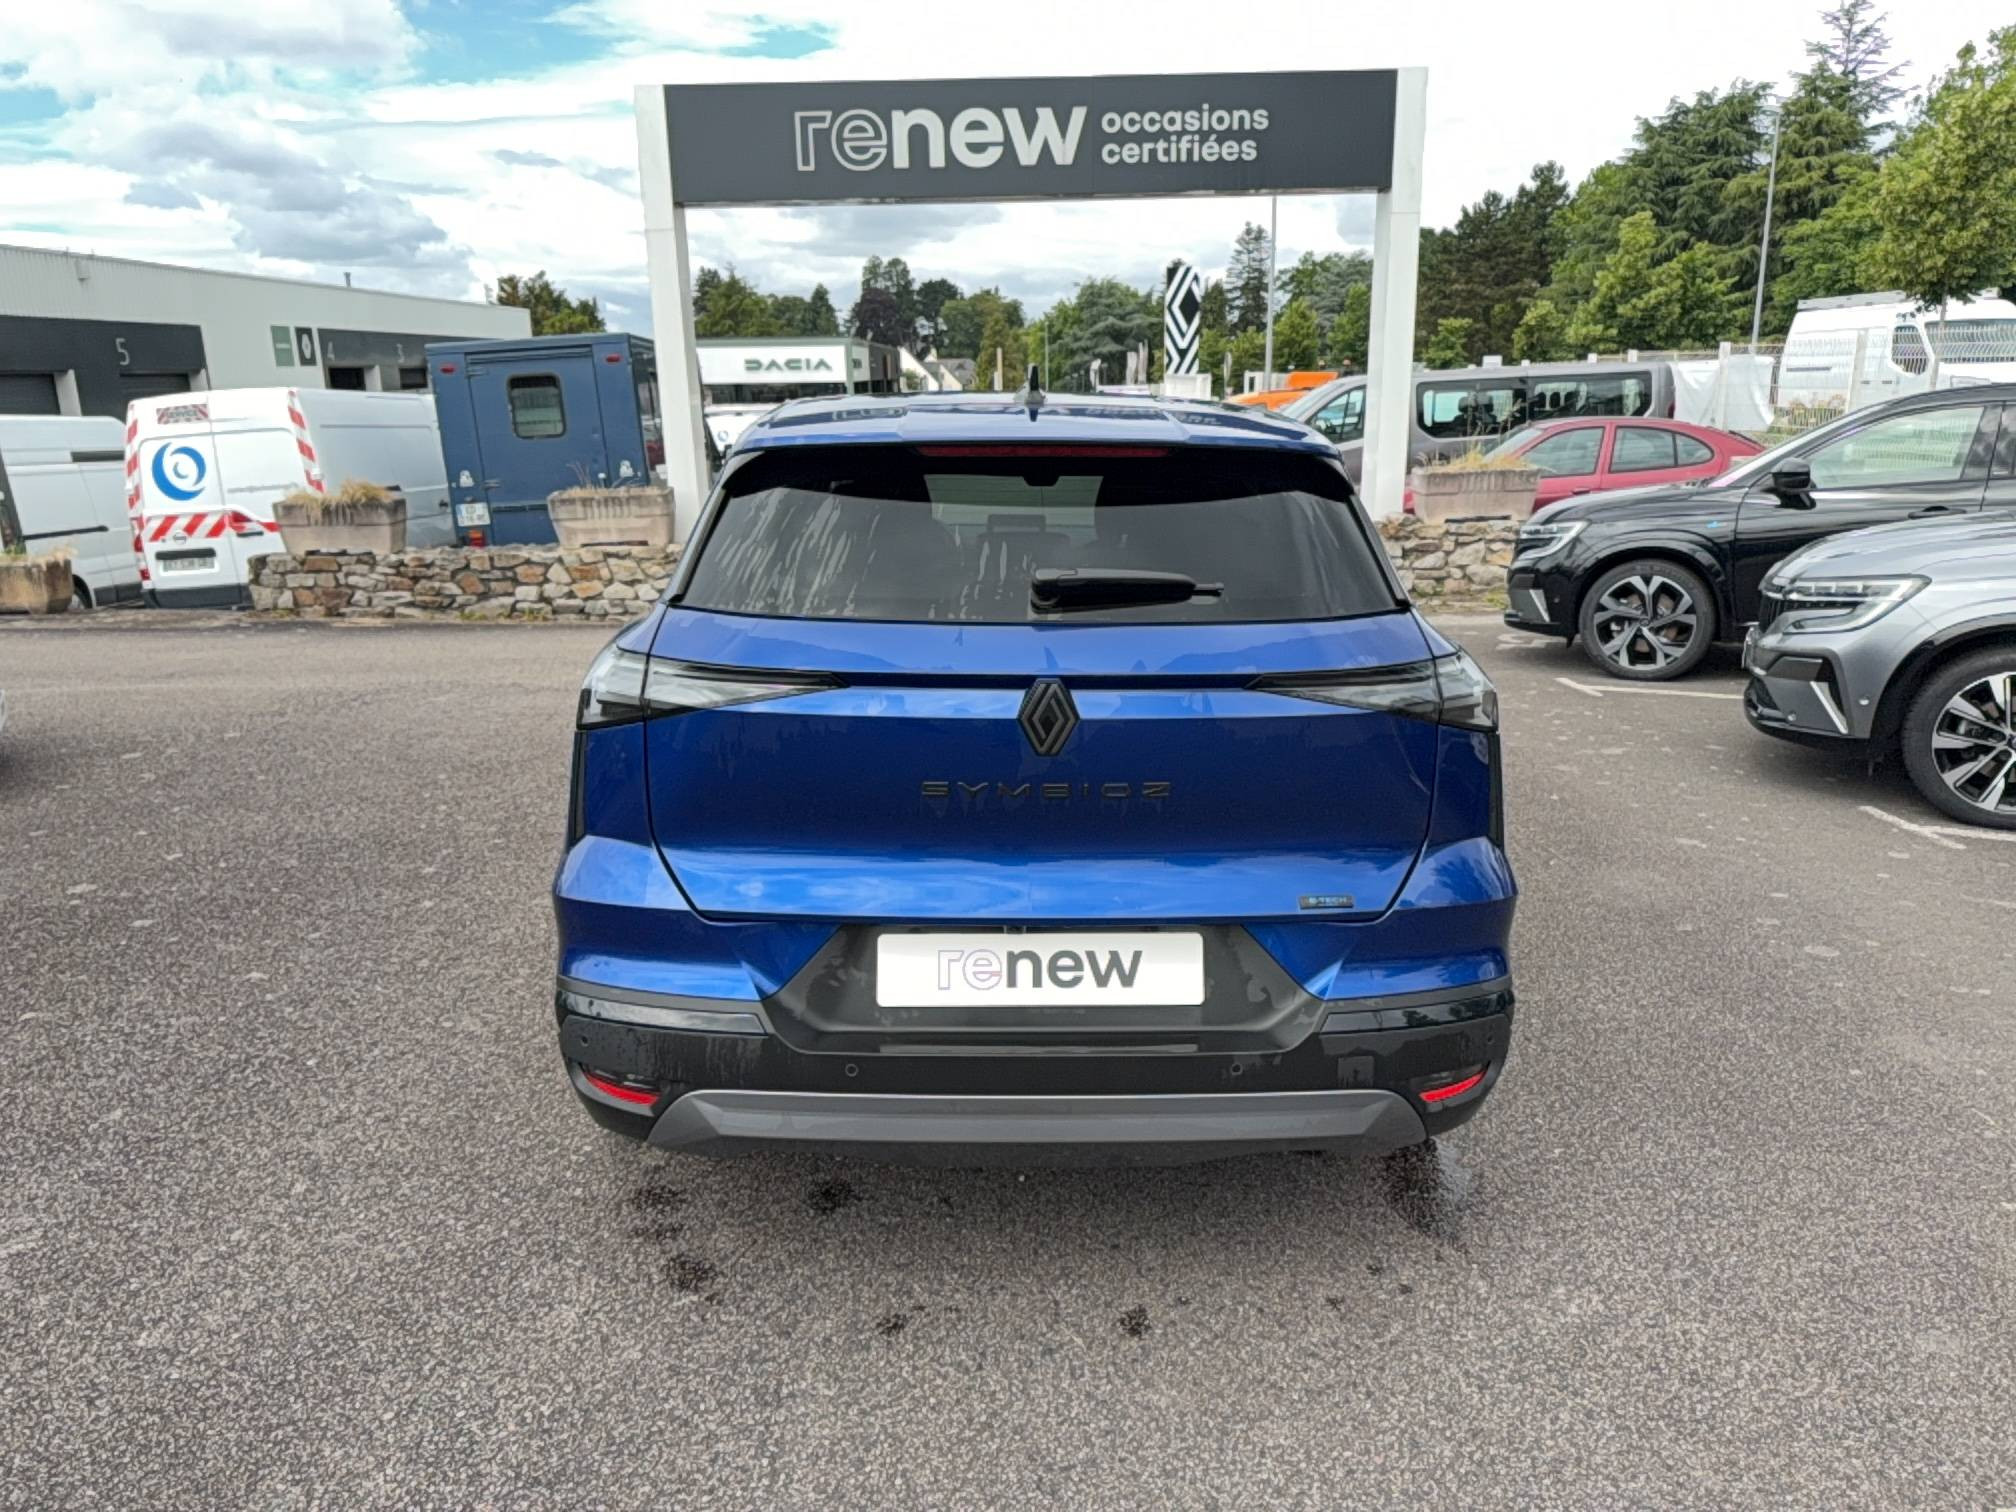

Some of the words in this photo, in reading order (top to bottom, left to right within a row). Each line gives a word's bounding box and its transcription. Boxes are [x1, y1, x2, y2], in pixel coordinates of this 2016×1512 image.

[1101, 103, 1270, 134] occasions
[793, 105, 1088, 172] renew
[1101, 134, 1258, 165] certifiées
[115, 337, 130, 366] 5
[743, 358, 833, 371] DACIA
[921, 781, 1171, 798] SYMBIOZ
[937, 948, 1143, 991] renew
